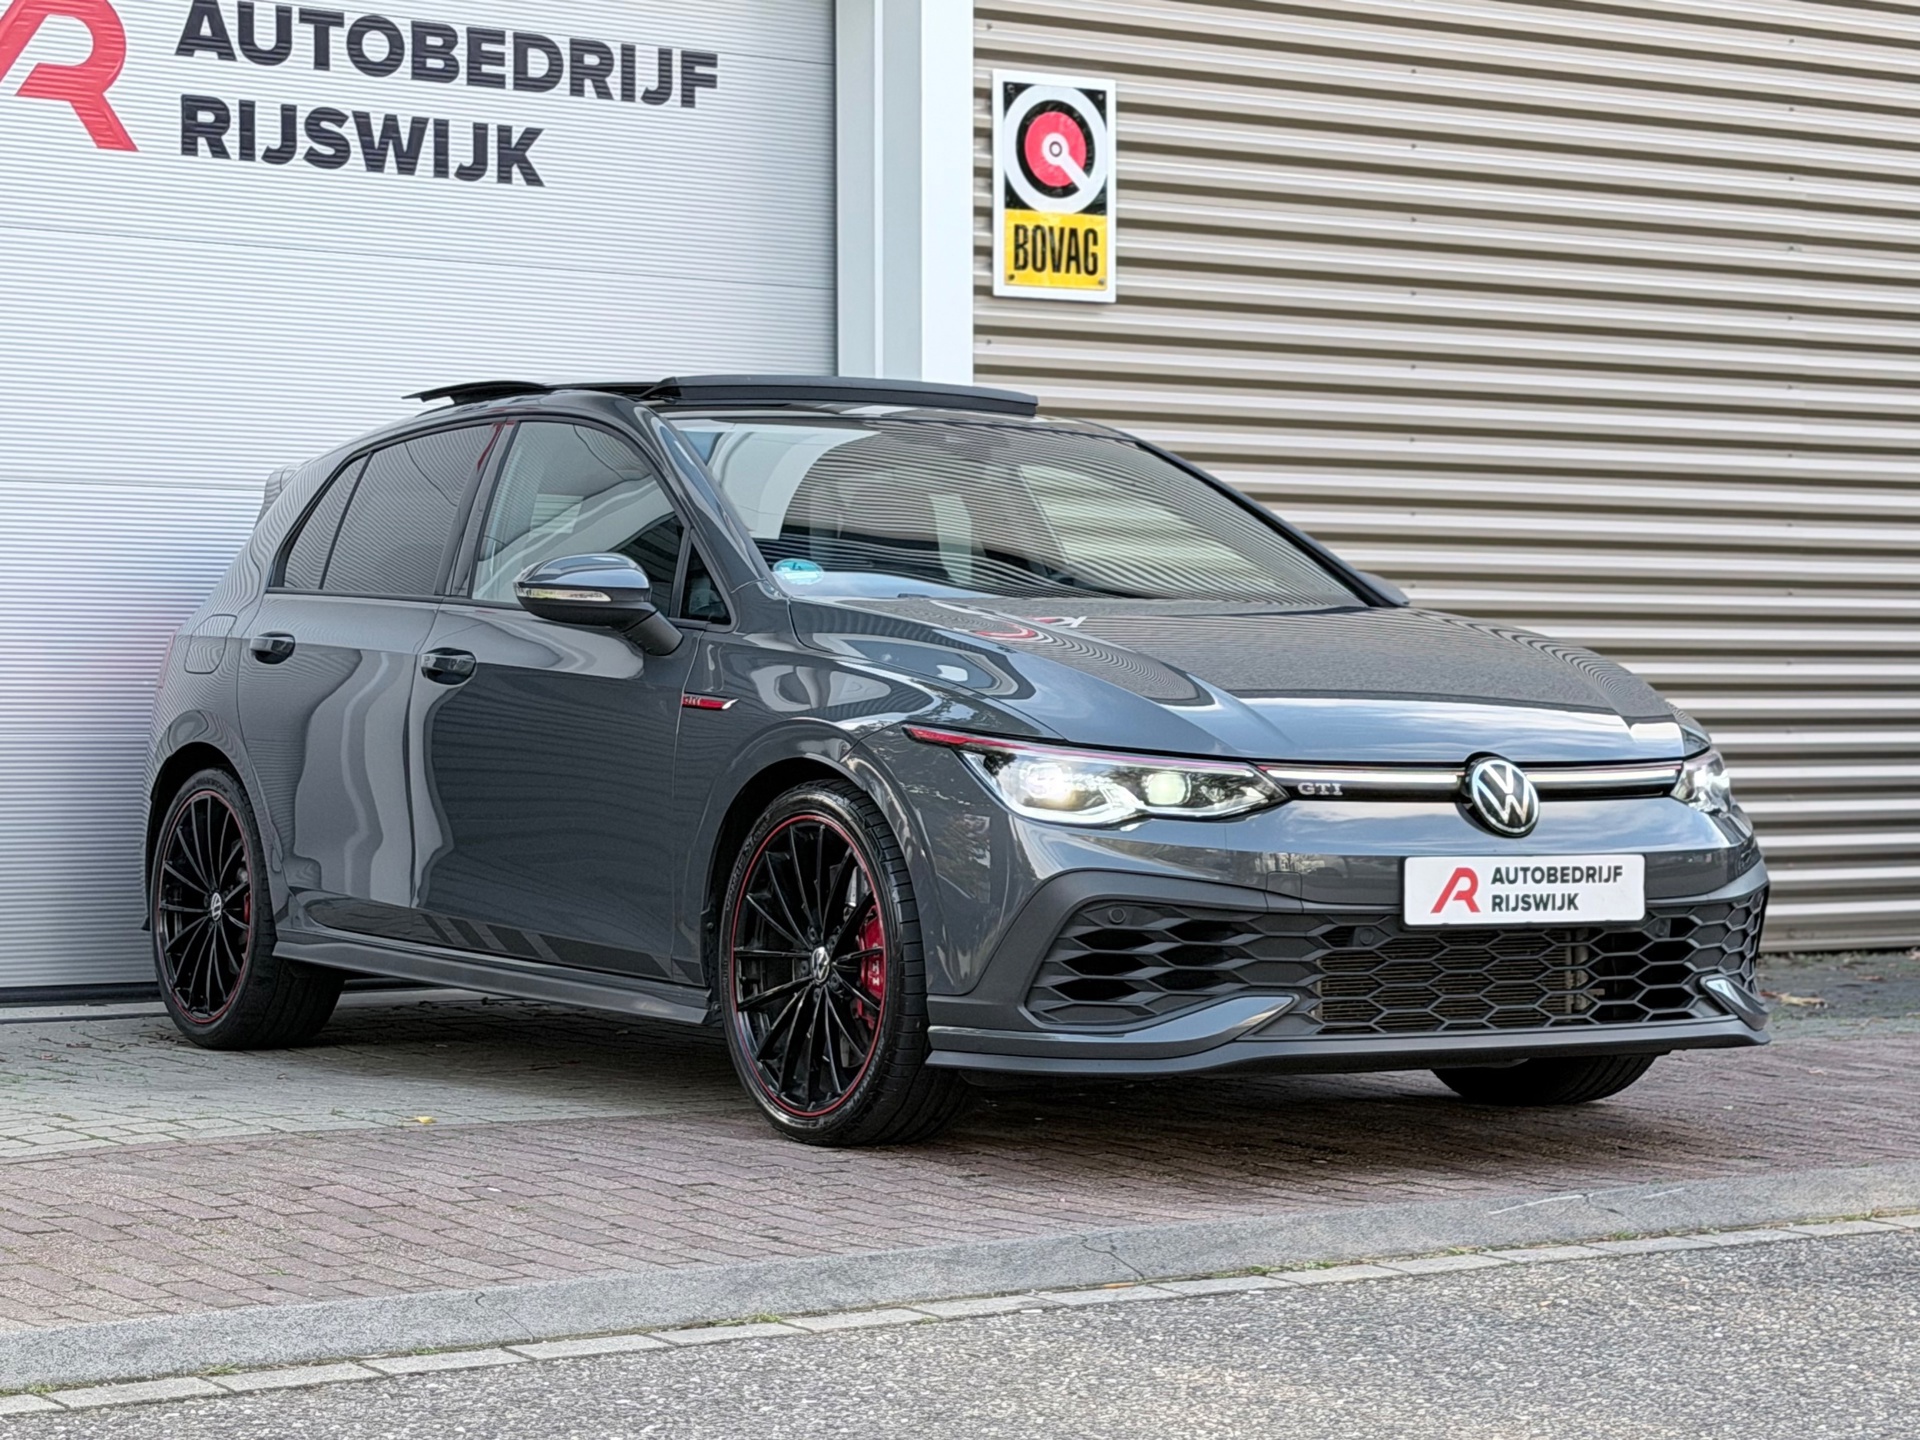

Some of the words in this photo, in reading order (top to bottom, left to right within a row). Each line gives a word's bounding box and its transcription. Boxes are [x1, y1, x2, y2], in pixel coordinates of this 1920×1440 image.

[174, 0, 718, 108] AUTOBEDRIJF
[180, 94, 545, 187] RIJSWIJK
[1014, 224, 1098, 276] BOVAG
[1297, 782, 1344, 796] GTI
[1491, 865, 1623, 885] AUTOBEDRIJF
[1491, 893, 1579, 912] RIJSWIJK
